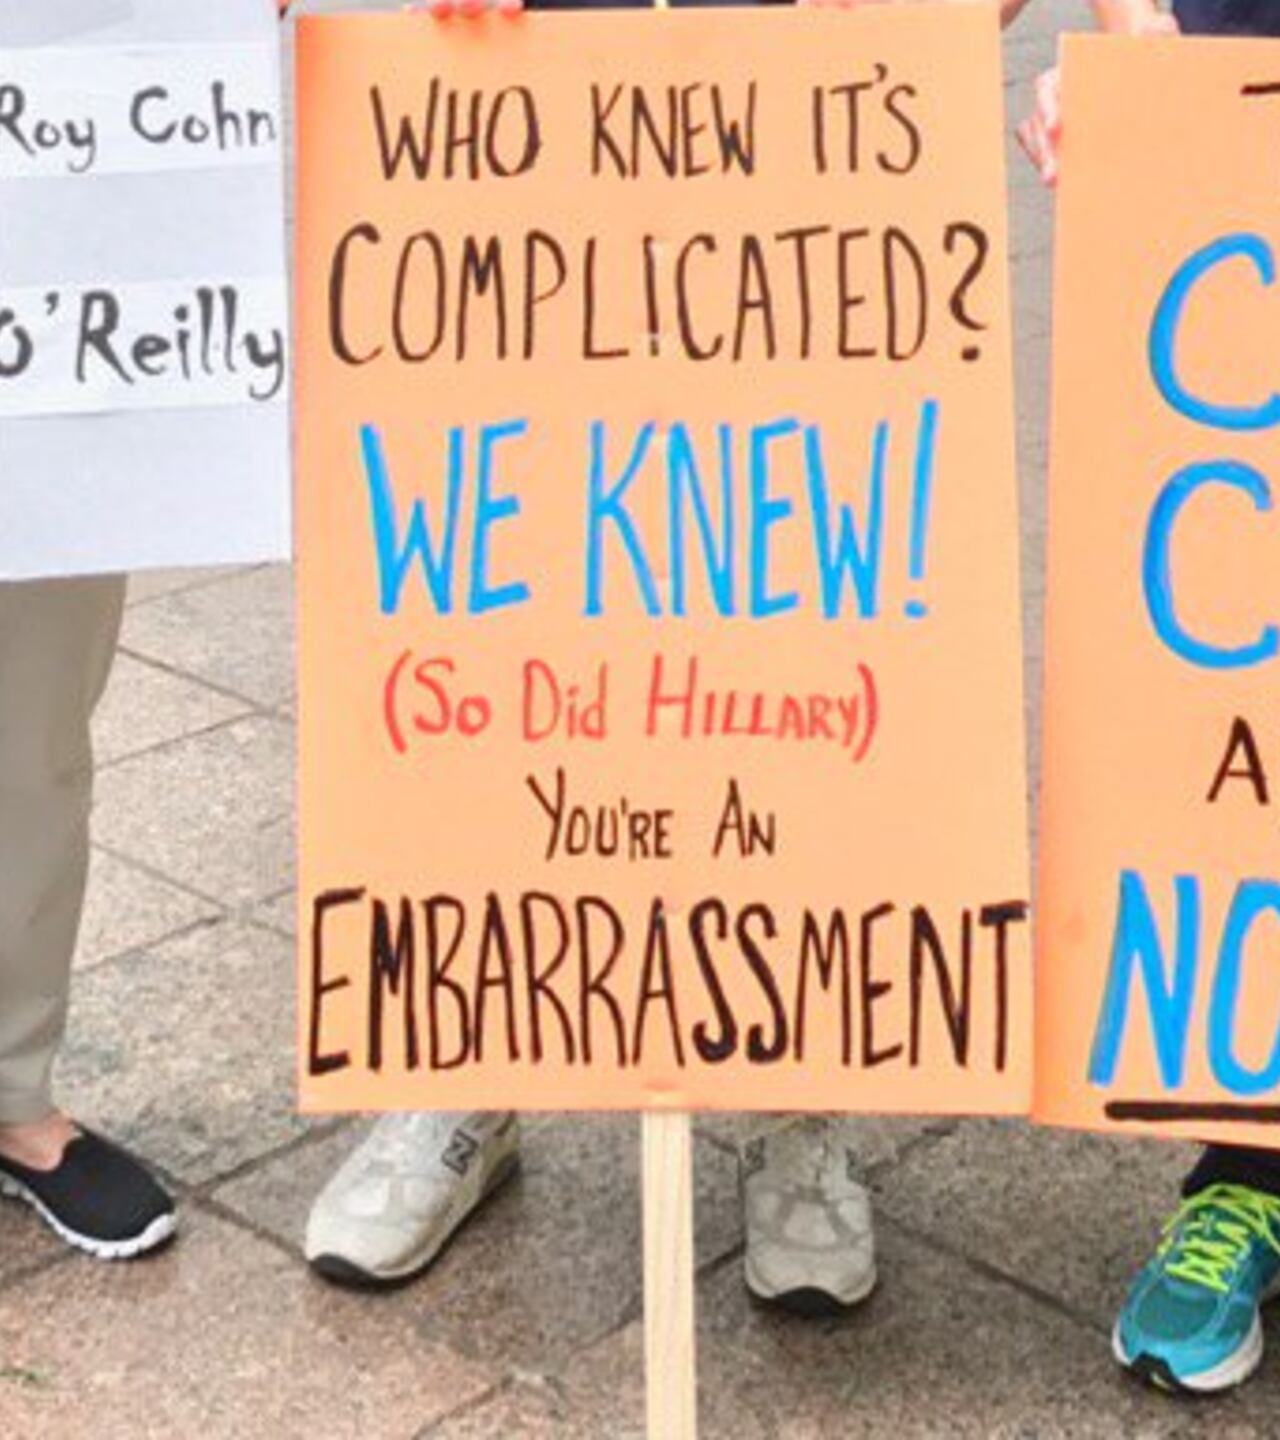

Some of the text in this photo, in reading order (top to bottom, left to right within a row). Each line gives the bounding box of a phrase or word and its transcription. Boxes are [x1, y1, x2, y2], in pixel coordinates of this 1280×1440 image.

[130, 81, 278, 152] Cohn
[369, 62, 922, 181] WHO KNEW IT'S
[327, 221, 989, 365] COMPLICATED?
[360, 399, 938, 620] WE KNEW!
[382, 648, 881, 763] (So Did HILLARY)
[525, 766, 777, 862] YOU'RE AN
[308, 886, 1027, 1076] EMBARRASSMENT
